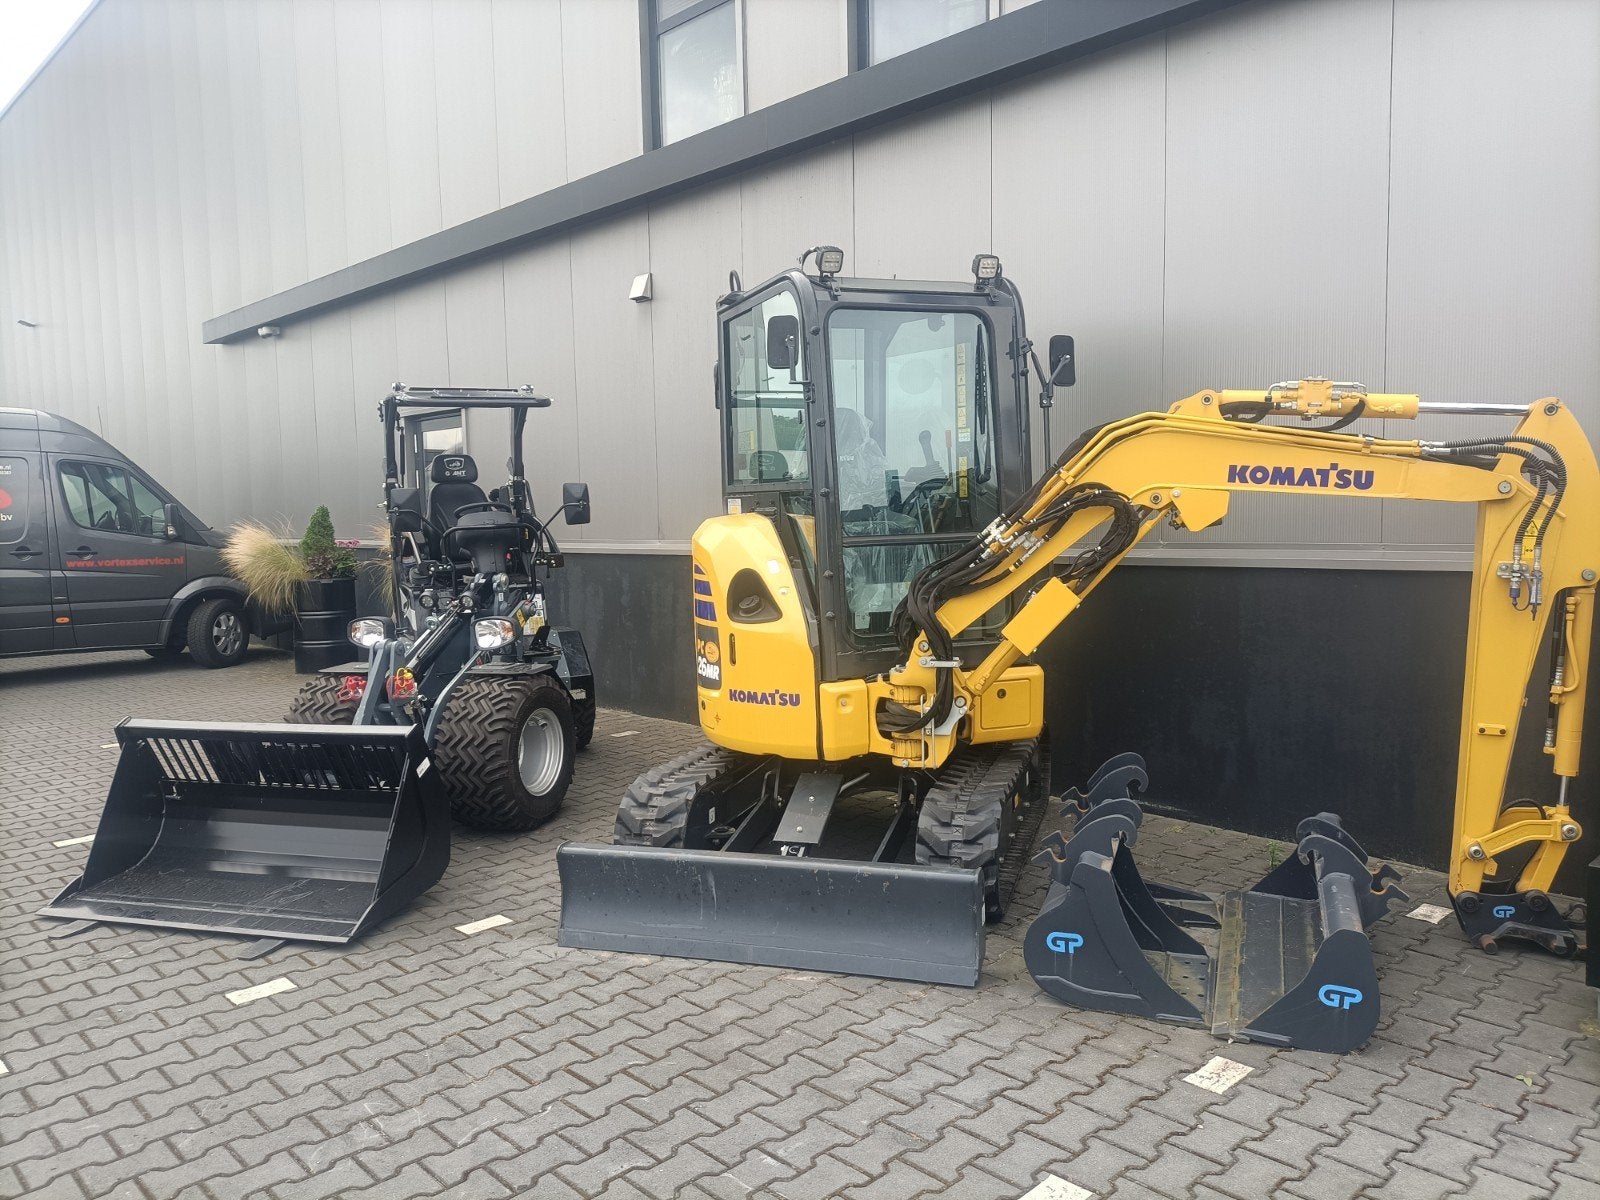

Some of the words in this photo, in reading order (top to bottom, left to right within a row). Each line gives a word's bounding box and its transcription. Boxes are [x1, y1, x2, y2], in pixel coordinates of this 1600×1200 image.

[1227, 463, 1375, 490] KOMATSU
[66, 556, 185, 568] www.vortexservice.nl
[728, 685, 801, 706] KOMATSU
[1492, 905, 1516, 918] GP
[1046, 931, 1085, 954] GP
[1318, 984, 1363, 1010] GP
